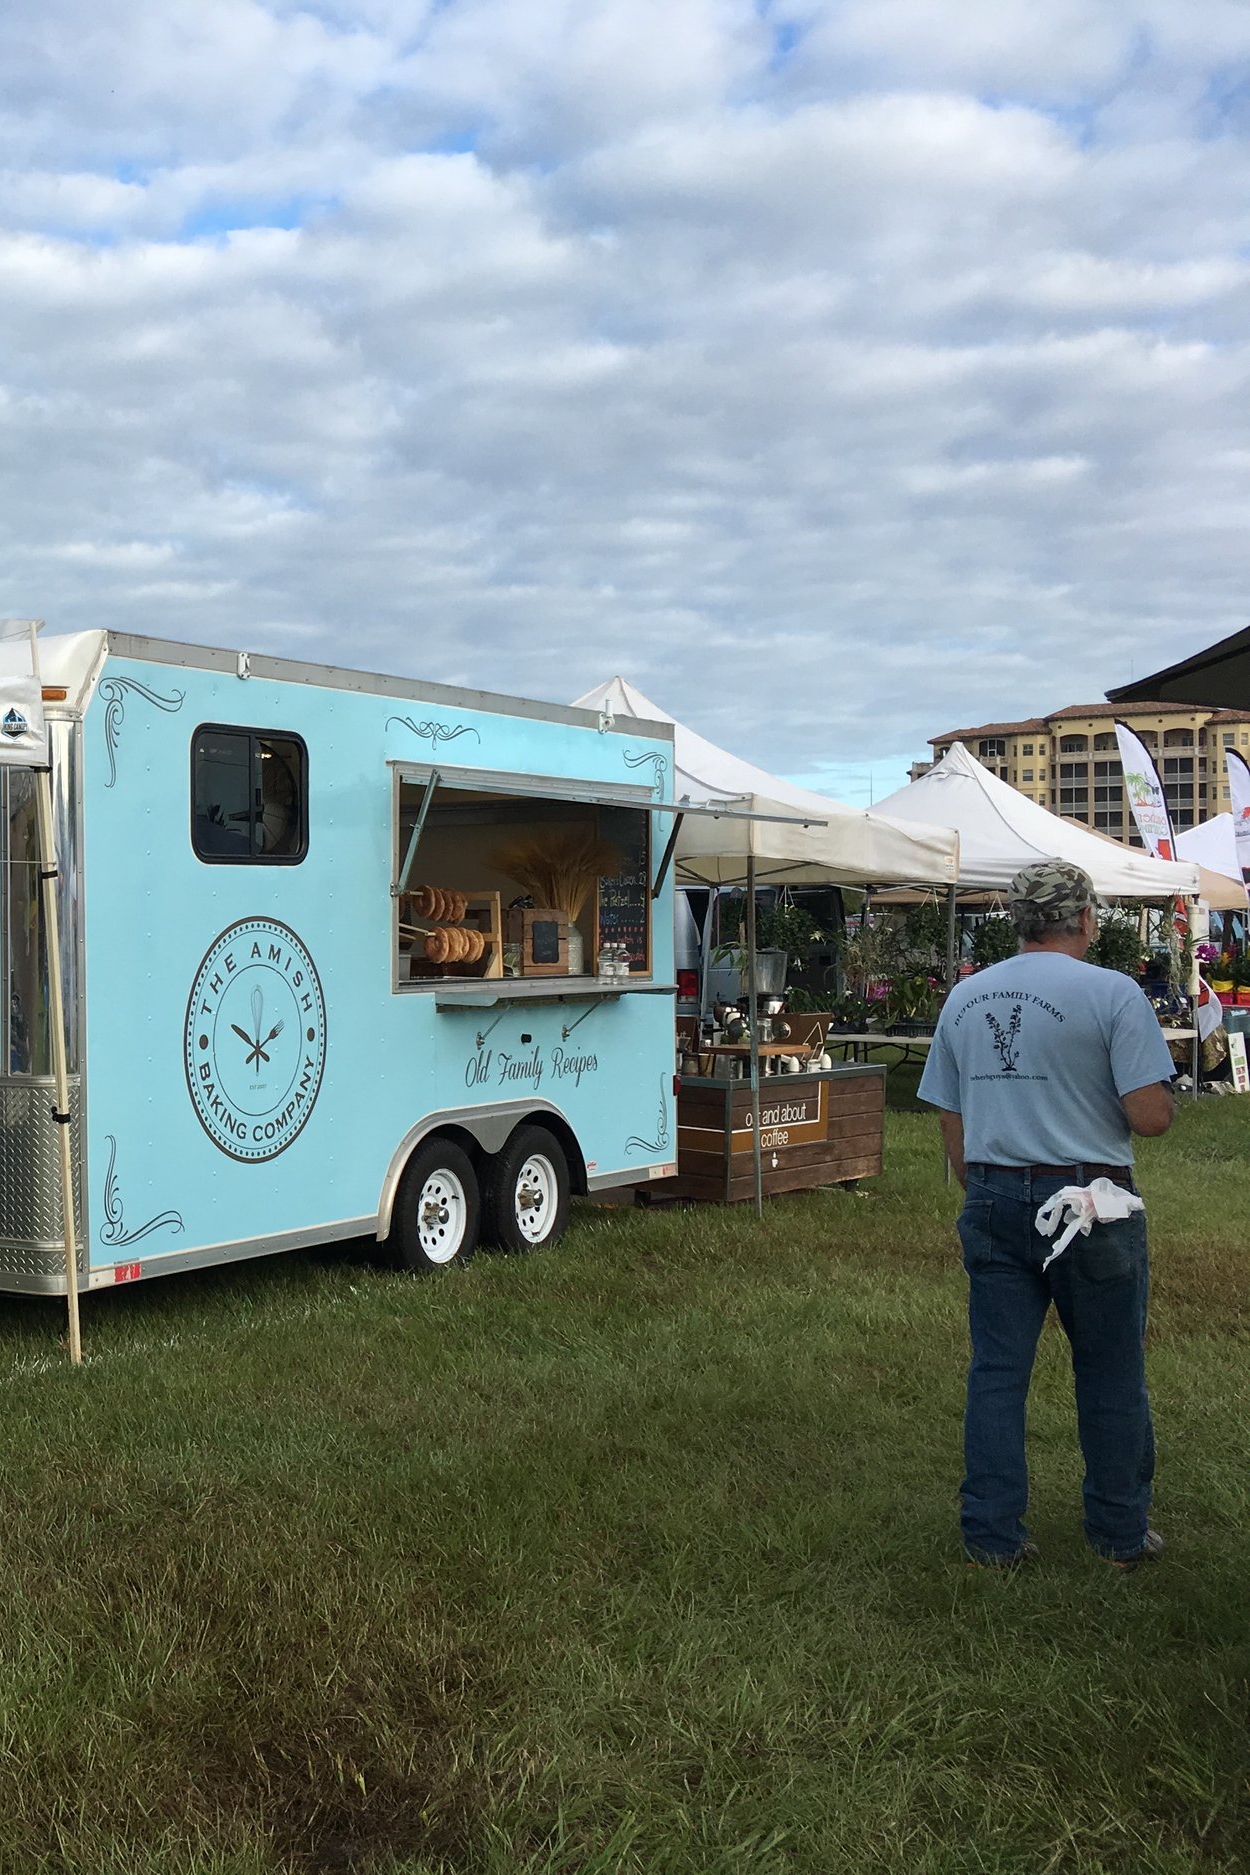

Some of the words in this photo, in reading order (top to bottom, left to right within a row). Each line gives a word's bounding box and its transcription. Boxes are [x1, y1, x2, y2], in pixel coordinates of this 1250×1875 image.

[200, 953, 237, 1016] THE
[250, 941, 313, 1013] AMISH
[992, 991, 1032, 1001] FAMILY
[1032, 996, 1067, 1023] FARMS
[465, 1049, 492, 1088] Old
[497, 1045, 543, 1090] Family
[551, 1046, 598, 1088] Recipes
[198, 1061, 247, 1140] BAKING
[252, 1055, 315, 1142] COMPANY
[762, 1105, 780, 1125] and
[780, 1102, 807, 1123] about
[760, 1128, 789, 1148] coffee
